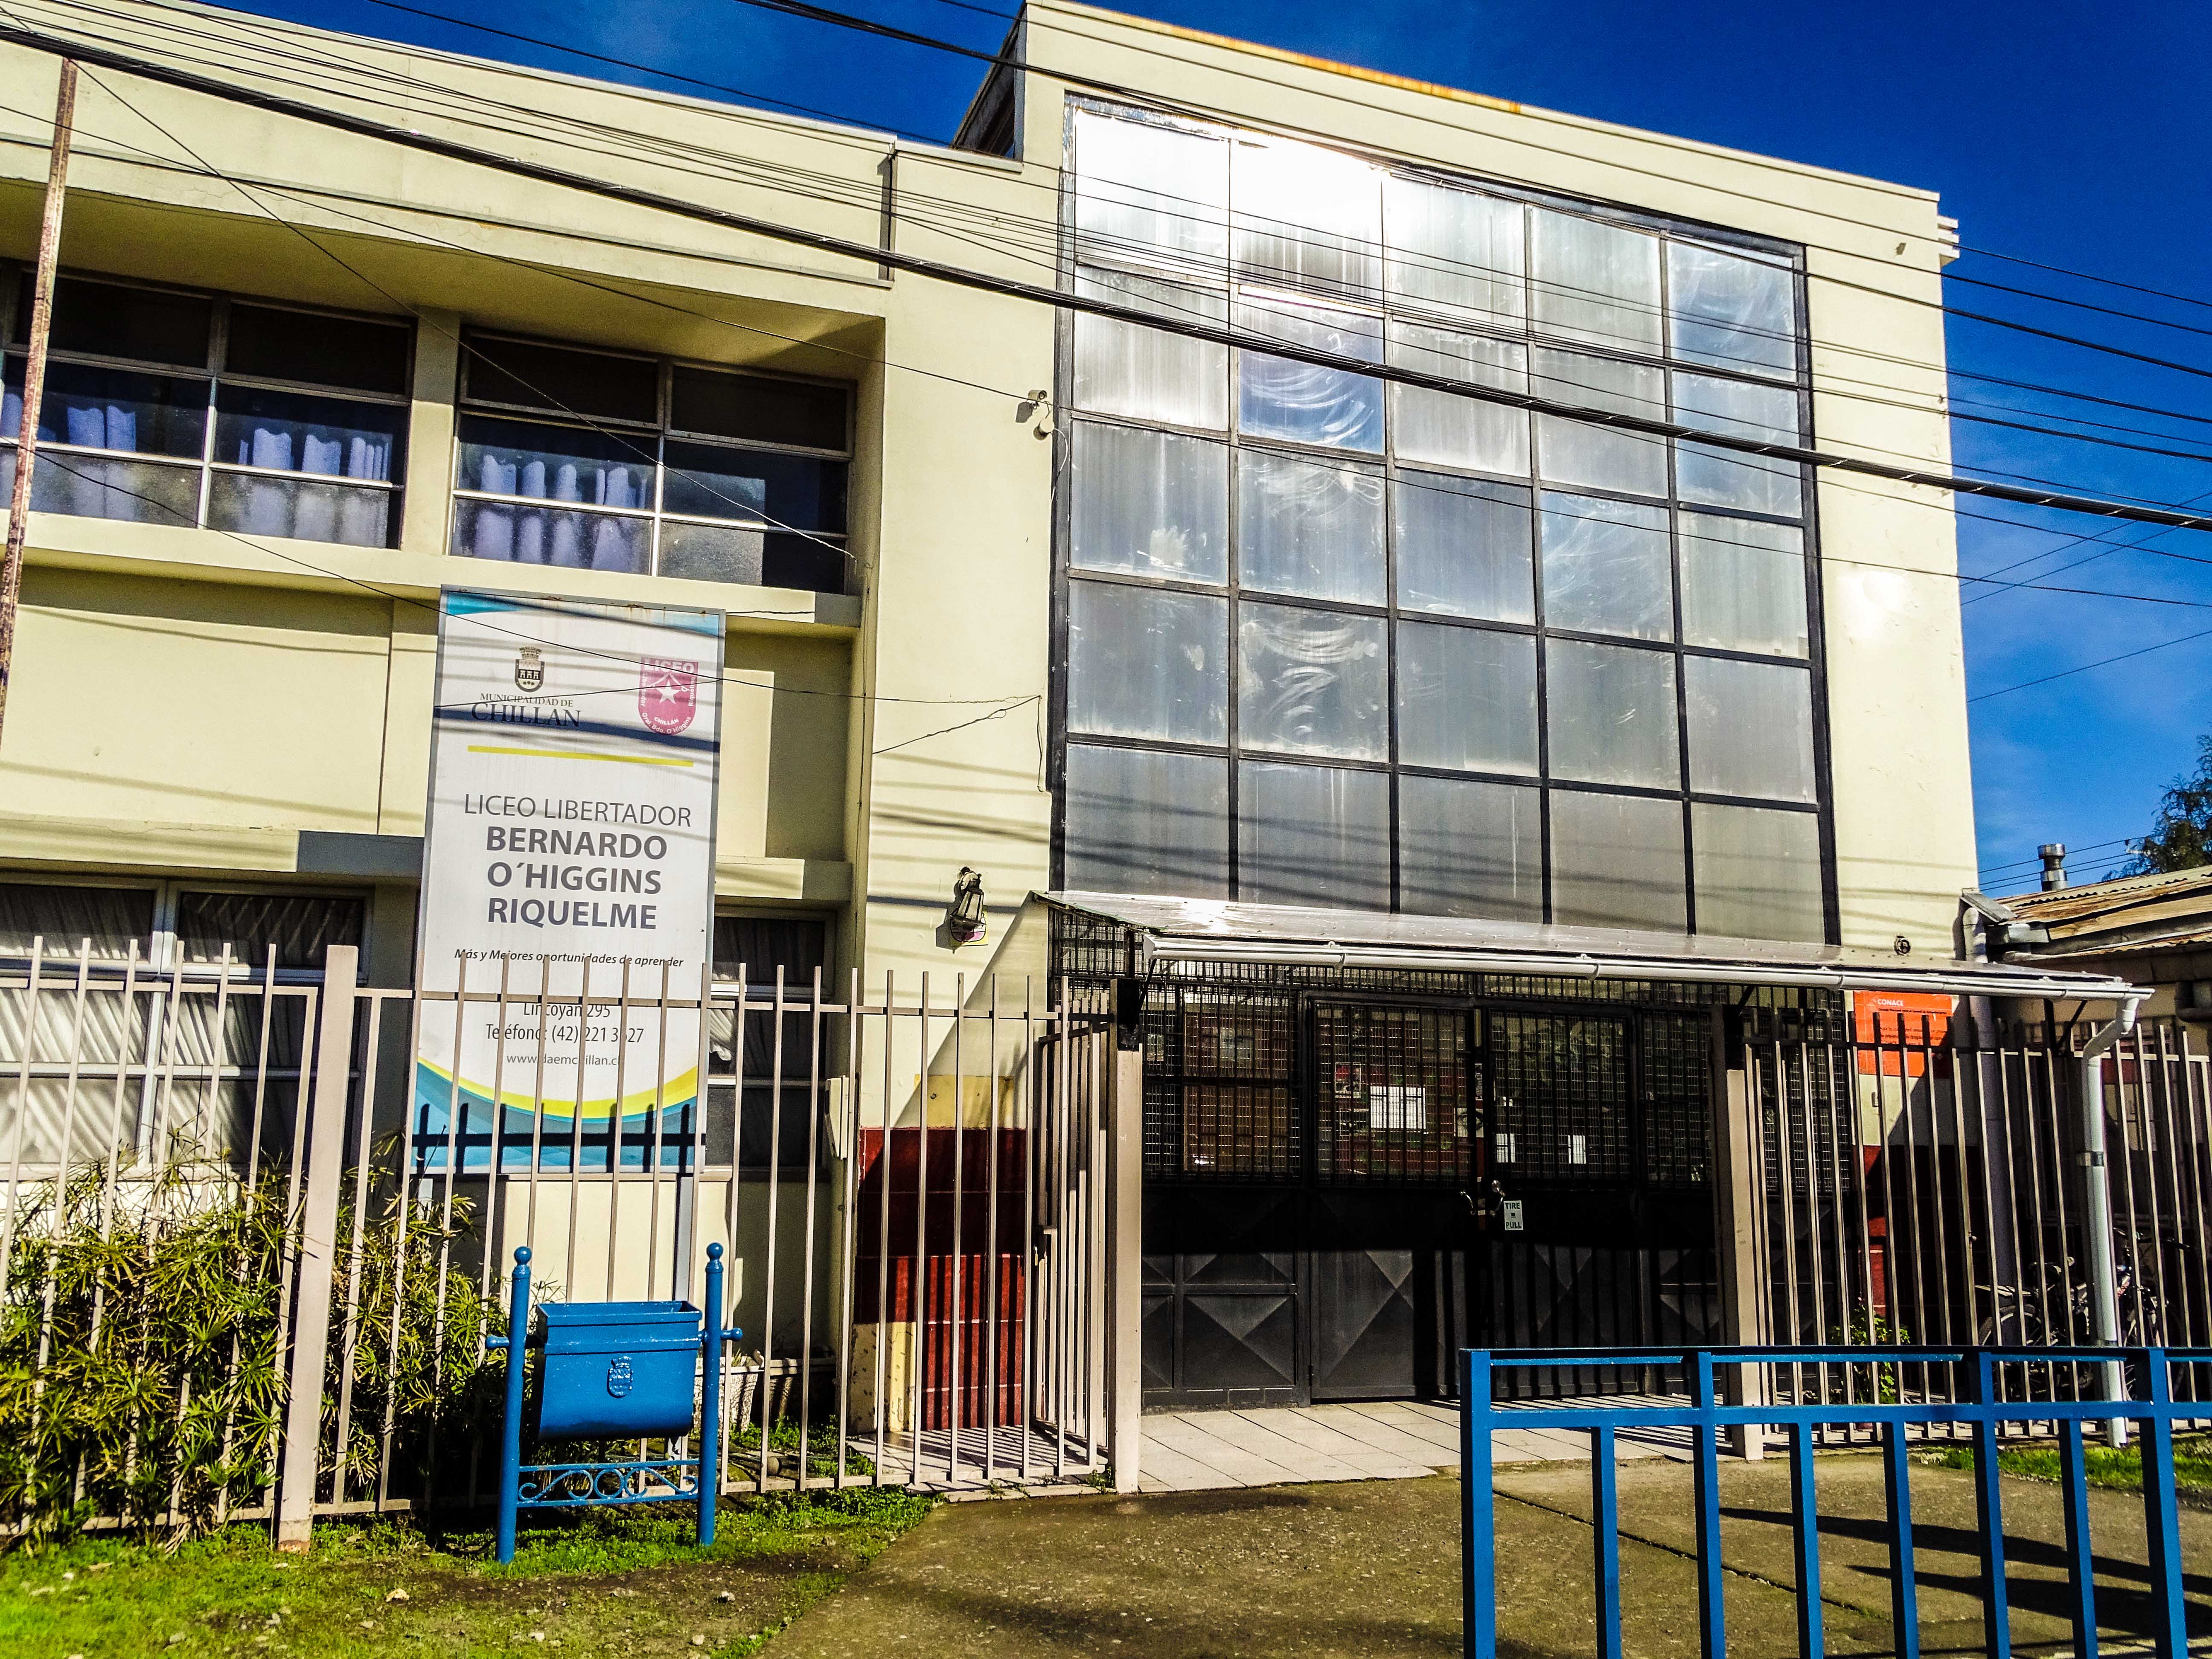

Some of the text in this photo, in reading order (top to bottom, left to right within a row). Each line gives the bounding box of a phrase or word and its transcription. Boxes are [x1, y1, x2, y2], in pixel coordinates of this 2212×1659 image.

[644, 658, 694, 673] LICEO
[480, 693, 559, 705] MUNICIPALIDAD
[464, 794, 691, 827] LICEO LIBERTADOR
[486, 826, 667, 860] BERNARDO
[488, 897, 657, 929] RIQUELME
[480, 952, 487, 961] y
[489, 950, 534, 961] Meores
[587, 1004, 610, 1018] 295
[486, 1024, 644, 1044] Teéfono: (42) 221 327
